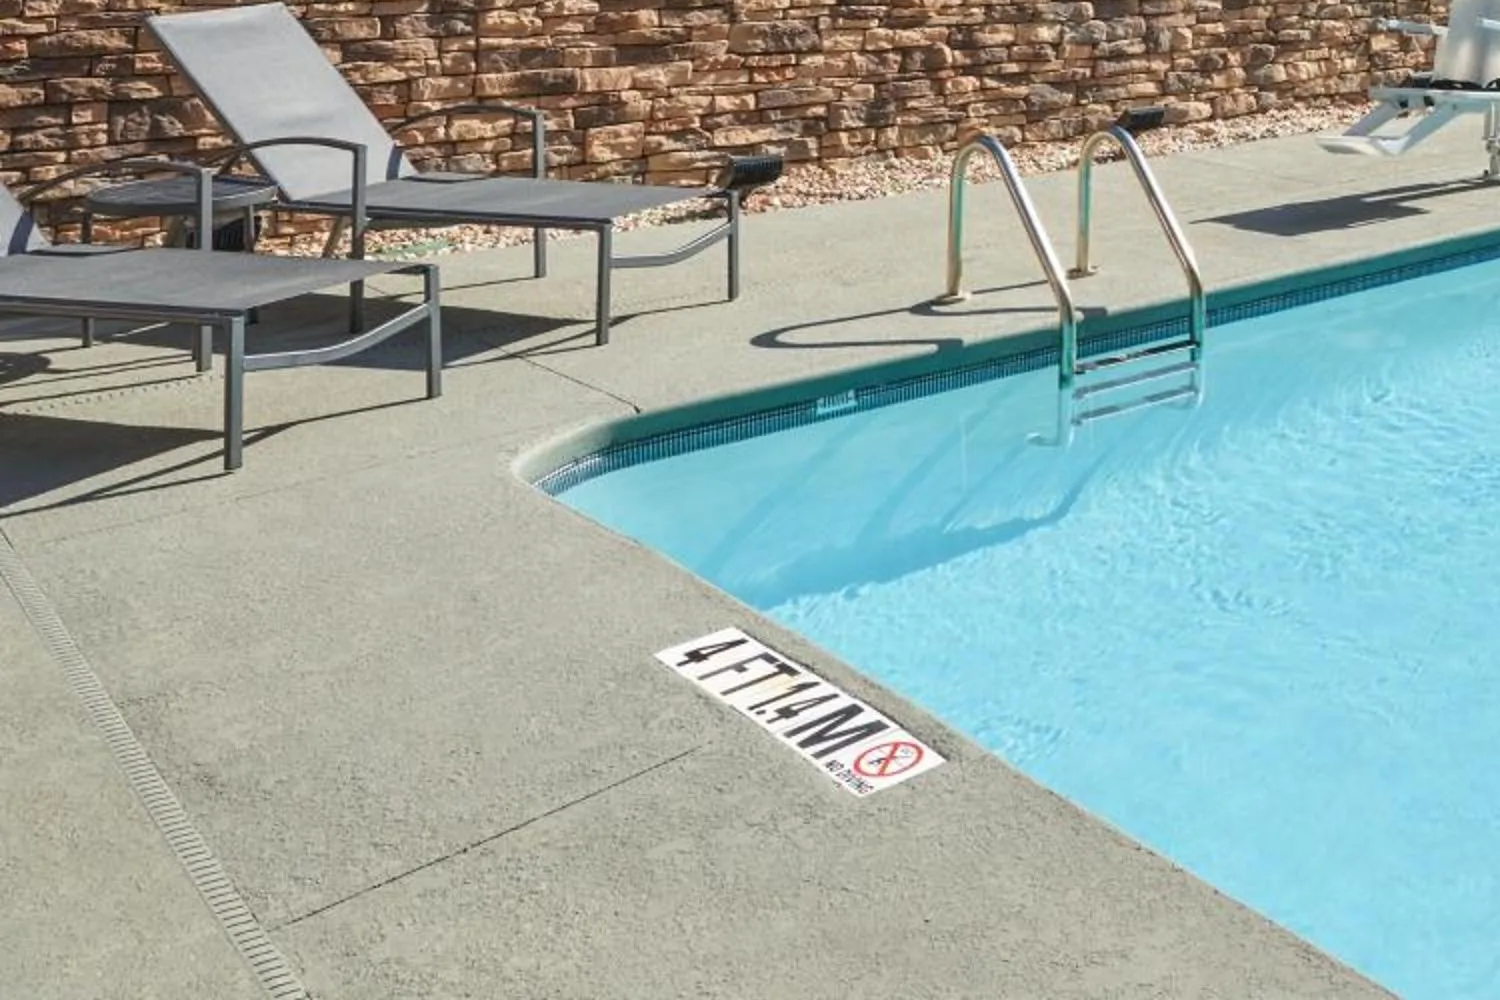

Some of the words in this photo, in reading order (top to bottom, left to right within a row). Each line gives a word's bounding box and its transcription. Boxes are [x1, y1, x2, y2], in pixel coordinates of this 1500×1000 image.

[676, 638, 749, 667] 4
[697, 652, 801, 696] FT
[825, 759, 845, 773] NO
